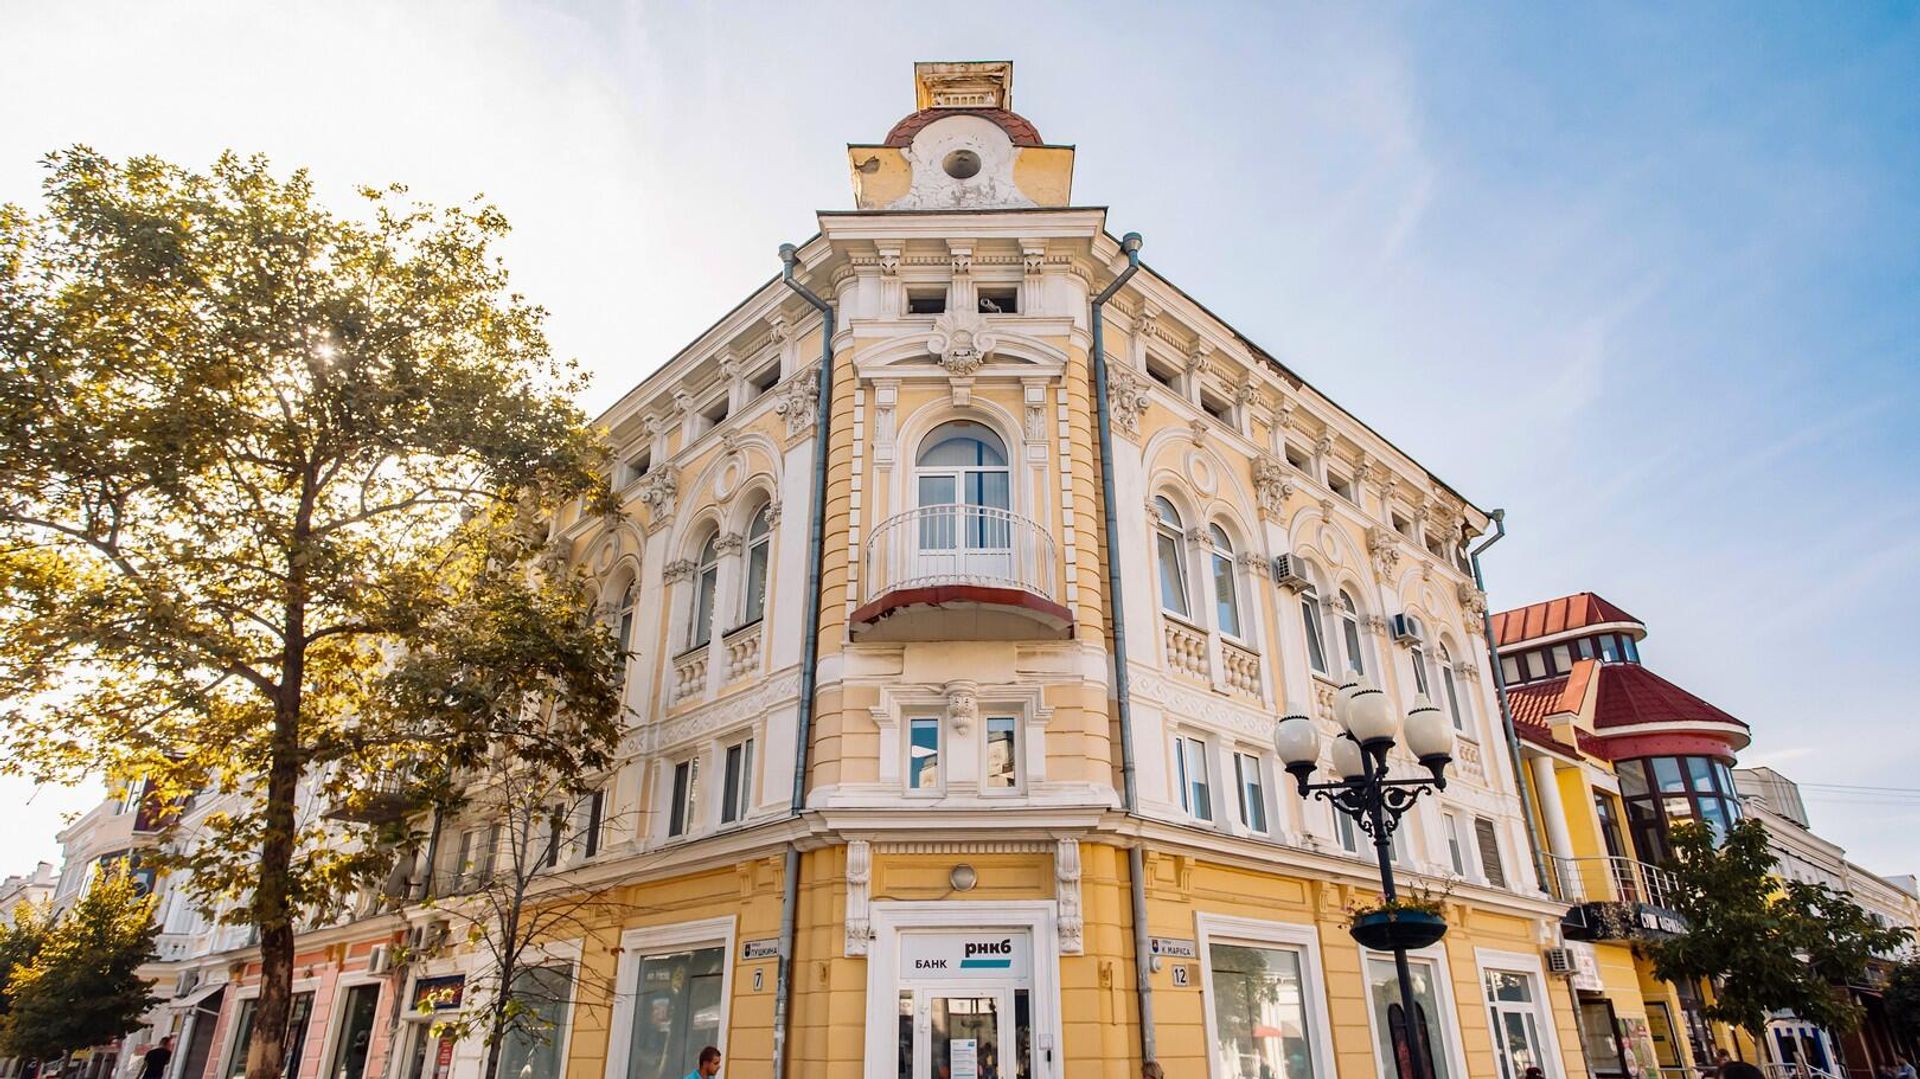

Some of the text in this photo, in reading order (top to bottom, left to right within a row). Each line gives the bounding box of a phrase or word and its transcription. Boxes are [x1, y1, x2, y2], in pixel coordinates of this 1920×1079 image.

[751, 947, 778, 957] ПУШКИНА
[965, 939, 1012, 958] рнкб
[915, 959, 948, 969] БАНК
[756, 972, 762, 987] 7
[1174, 968, 1187, 983] 12
